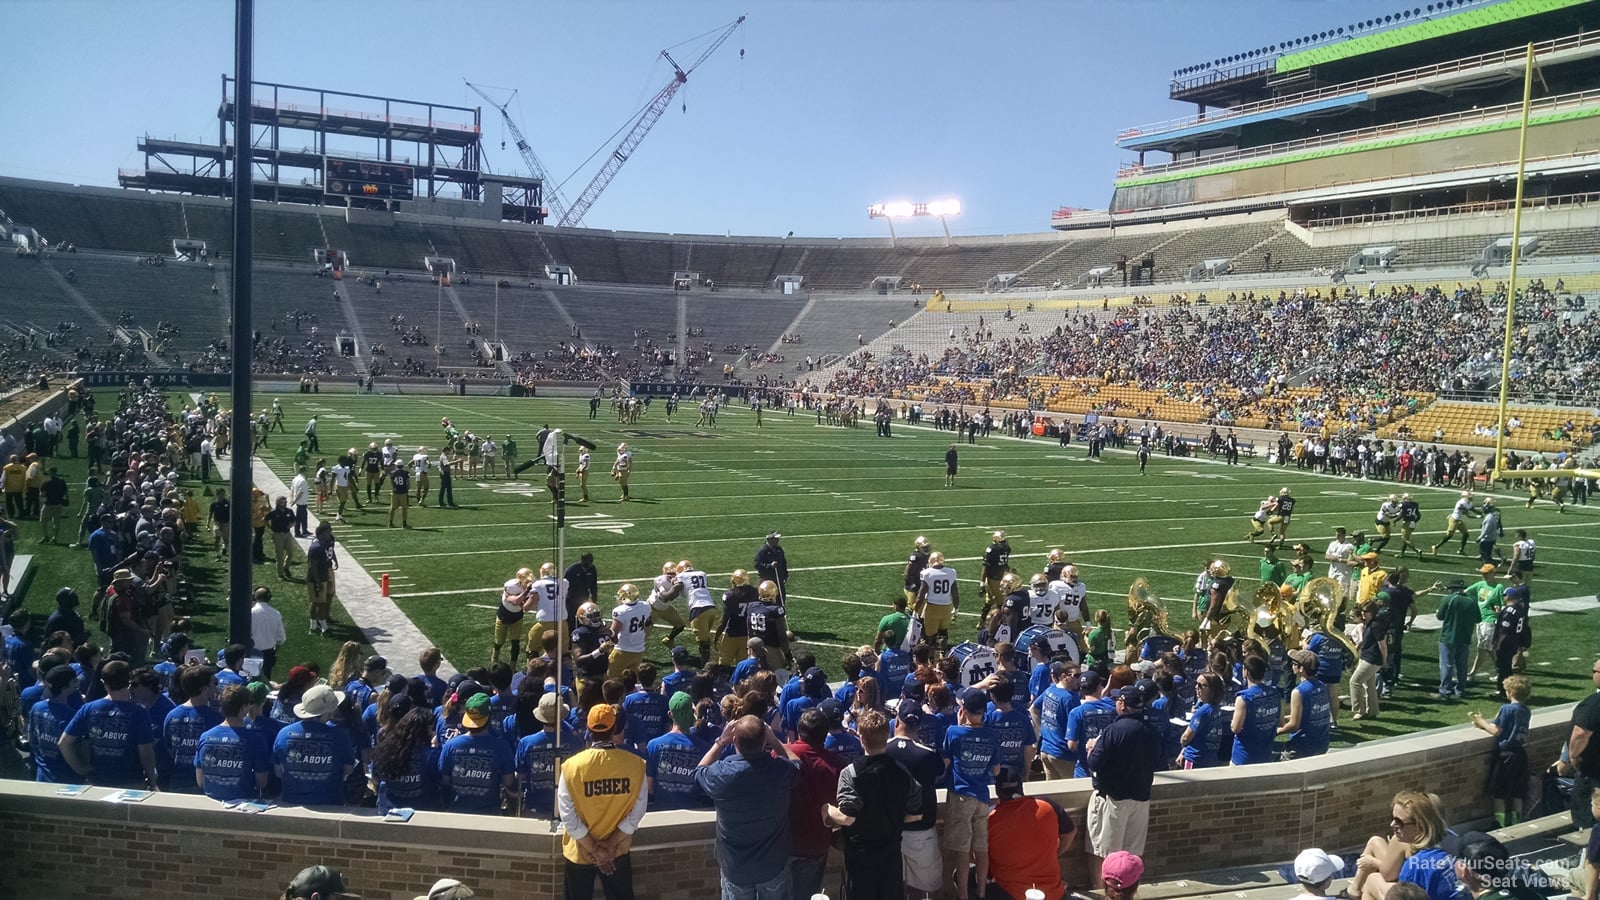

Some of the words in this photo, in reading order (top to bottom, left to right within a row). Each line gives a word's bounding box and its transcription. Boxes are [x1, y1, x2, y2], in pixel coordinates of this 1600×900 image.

[89, 375, 129, 383] NOTRE
[635, 385, 710, 393] FIGHTIG
[1282, 501, 1293, 511] 28
[933, 579, 950, 594] 60
[1035, 603, 1052, 618] 75
[103, 731, 128, 740] ABOVE
[1000, 740, 1023, 748] ABOVE
[216, 759, 244, 769] ABOVE
[302, 755, 333, 764] ABOVE
[465, 770, 492, 780] ABOVE
[672, 766, 695, 777] ABOV
[583, 777, 630, 798] USHER
